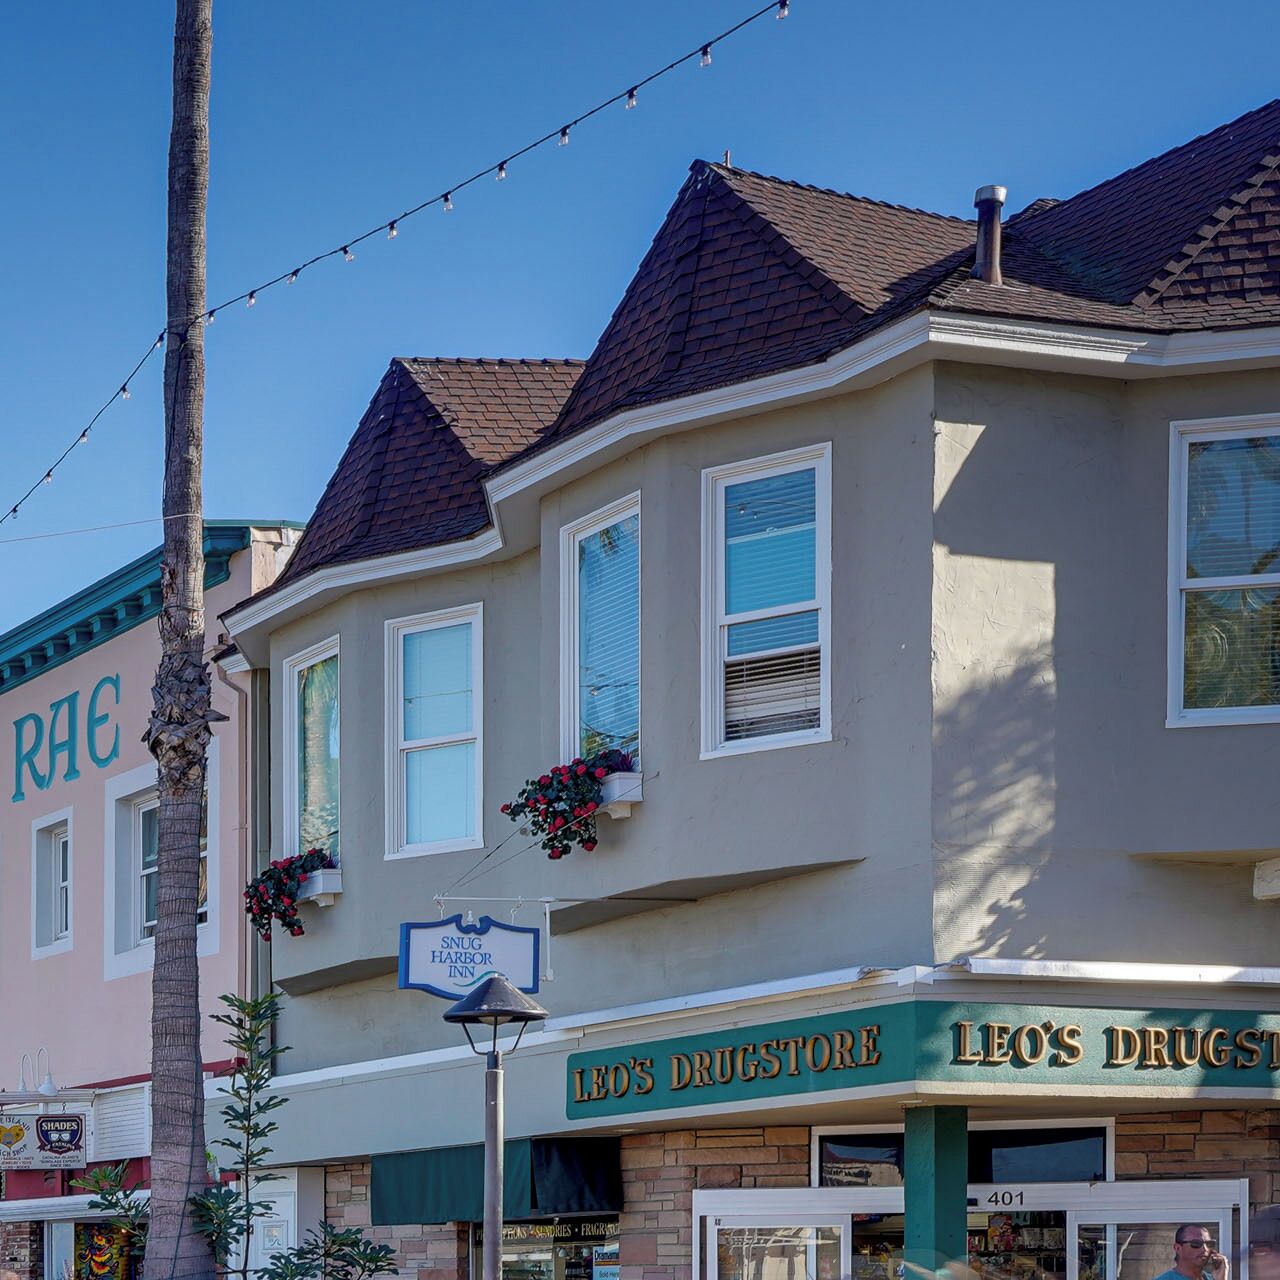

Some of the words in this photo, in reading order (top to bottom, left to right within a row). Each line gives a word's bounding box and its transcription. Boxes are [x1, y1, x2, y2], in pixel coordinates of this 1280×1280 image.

[11, 672, 121, 803] RAE
[441, 936, 482, 950] SNUG
[431, 950, 493, 965] HARBOR
[448, 965, 475, 978] INN
[957, 1019, 1084, 1066] LEO'S
[571, 1056, 654, 1103] LEO'S
[669, 1024, 881, 1090] DRUGSTORE
[41, 1121, 78, 1130] SHADES
[987, 1191, 1024, 1206] 401
